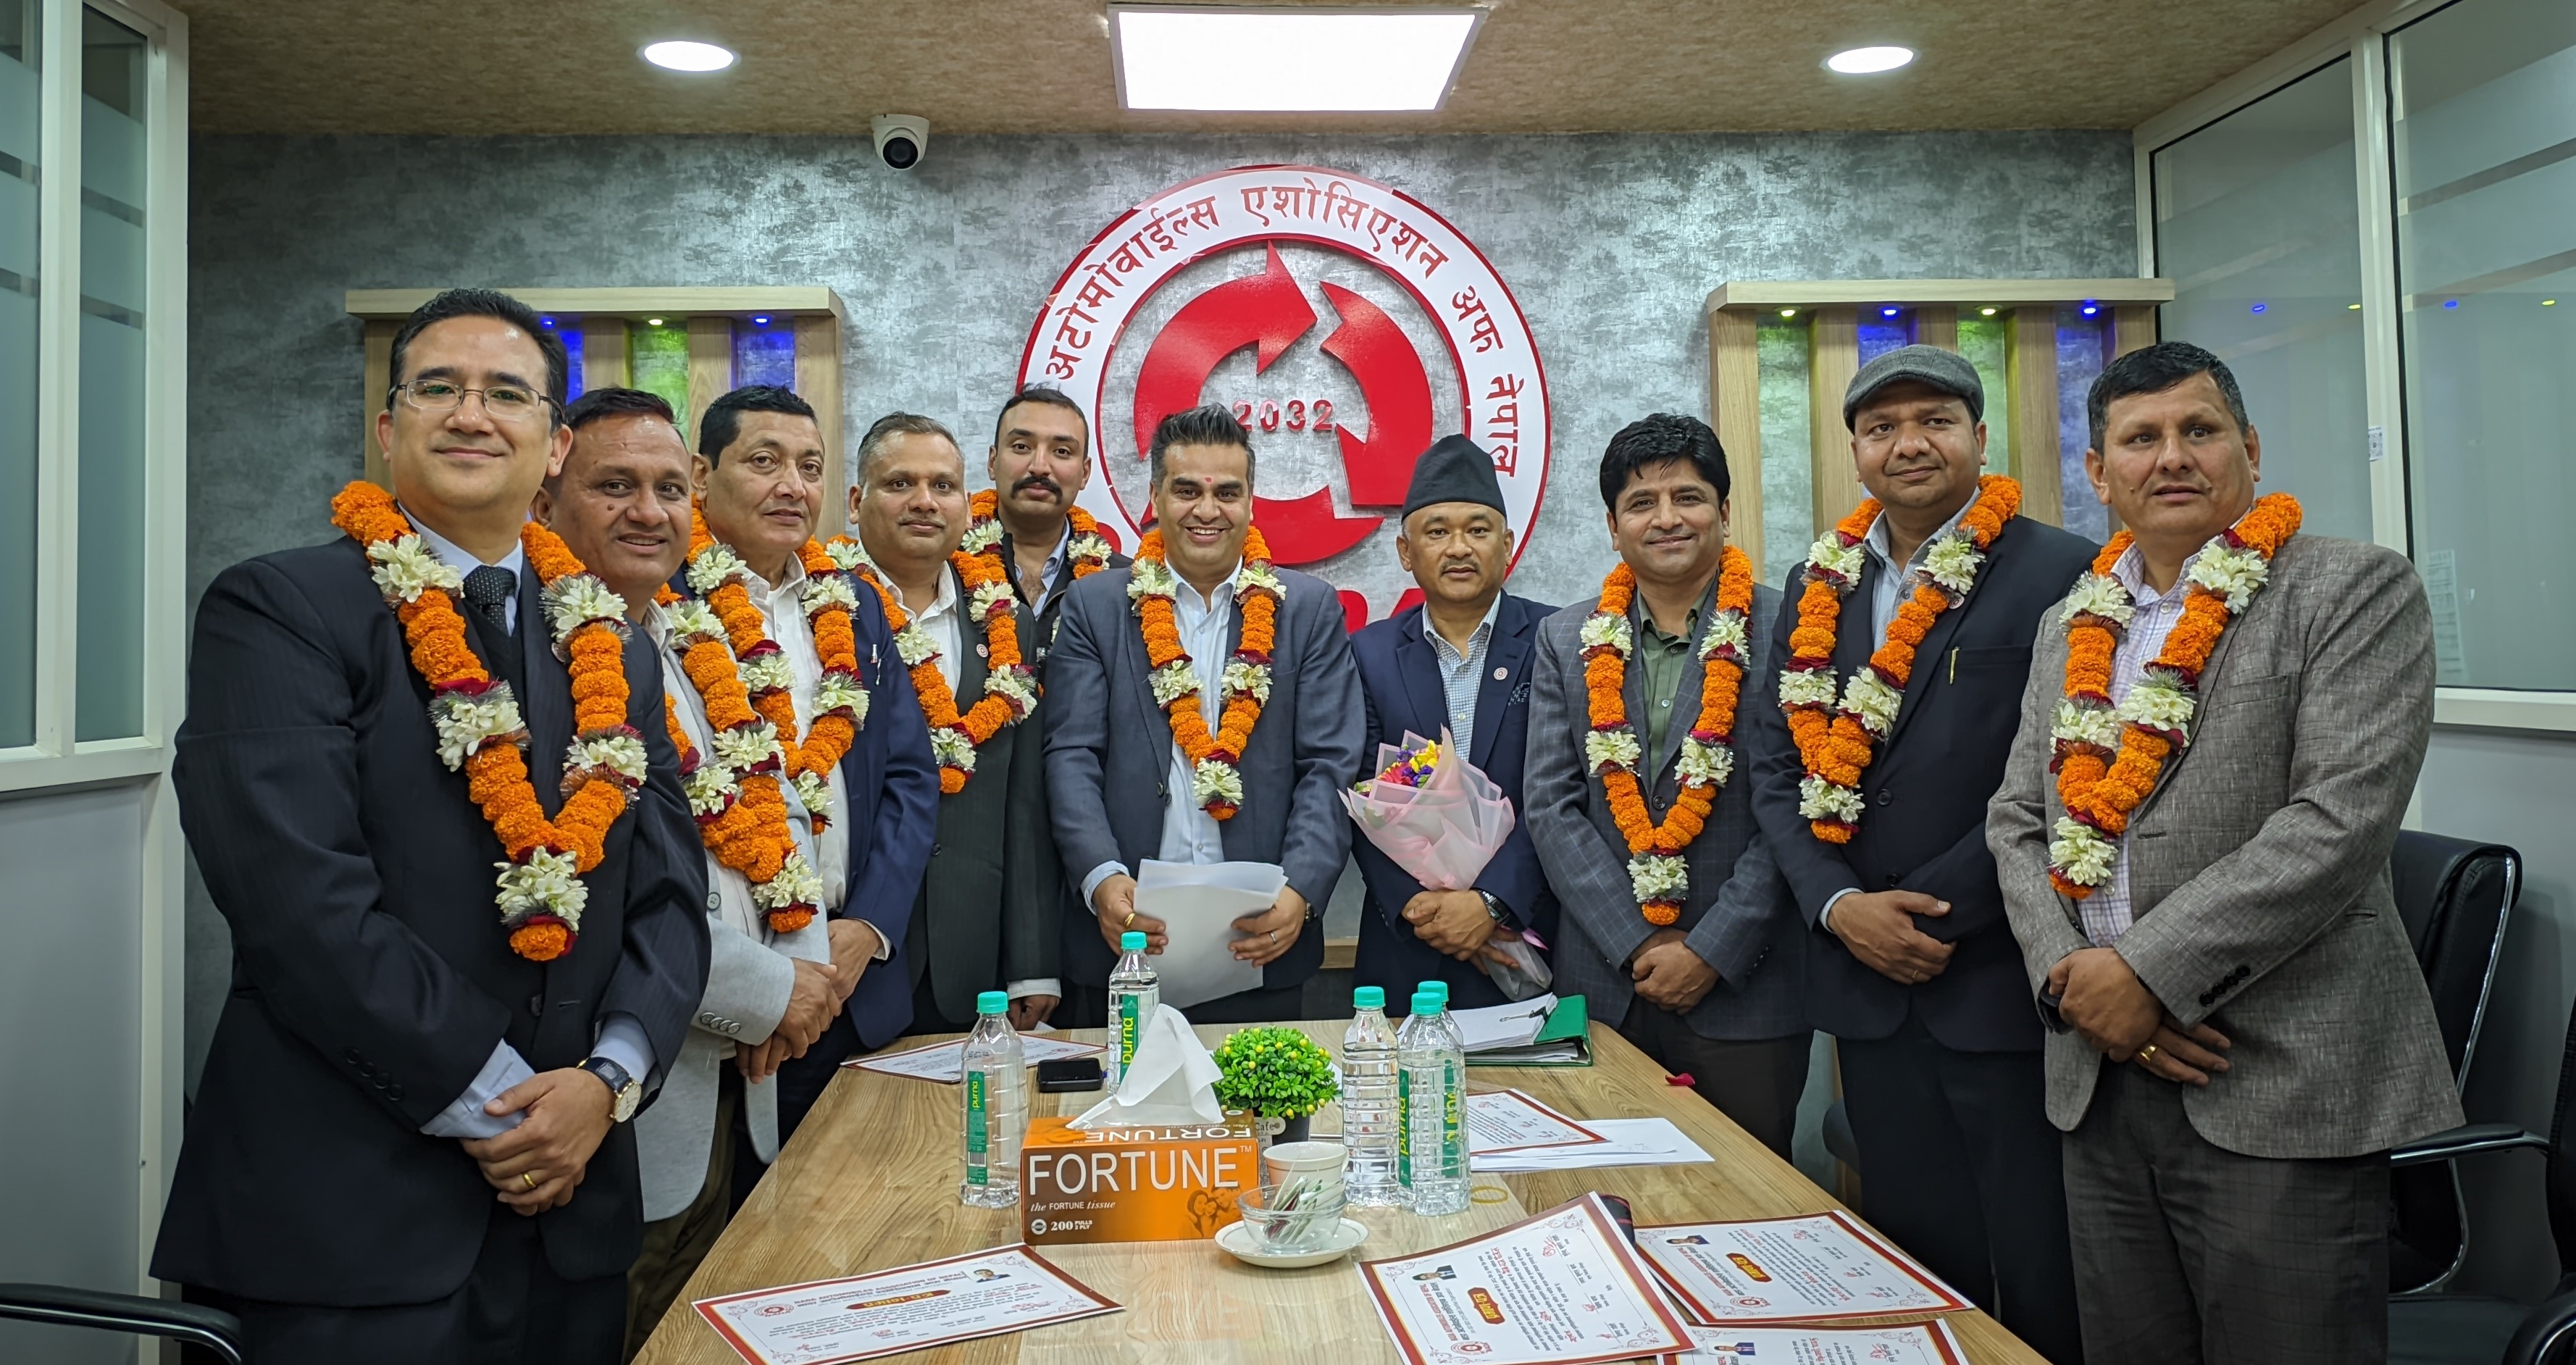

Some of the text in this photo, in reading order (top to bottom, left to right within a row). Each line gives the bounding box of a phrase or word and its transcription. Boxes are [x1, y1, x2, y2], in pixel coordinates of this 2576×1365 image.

[1046, 178, 1524, 477] अटोमोवाईल्स एशोसिएशन अफ नेपाल
[1232, 399, 1333, 431] 2032
[971, 1081, 981, 1109] purna
[1084, 1127, 1252, 1143] FORTUNE
[1255, 1122, 1275, 1131] Cafe
[1400, 1097, 1409, 1156] purna
[1029, 1148, 1239, 1195] FORTUNE
[1031, 1201, 1116, 1212] the FORTUNE tissue
[1050, 1221, 1074, 1231] 200
[1473, 1293, 1500, 1319] प्रमाण-पत्र
